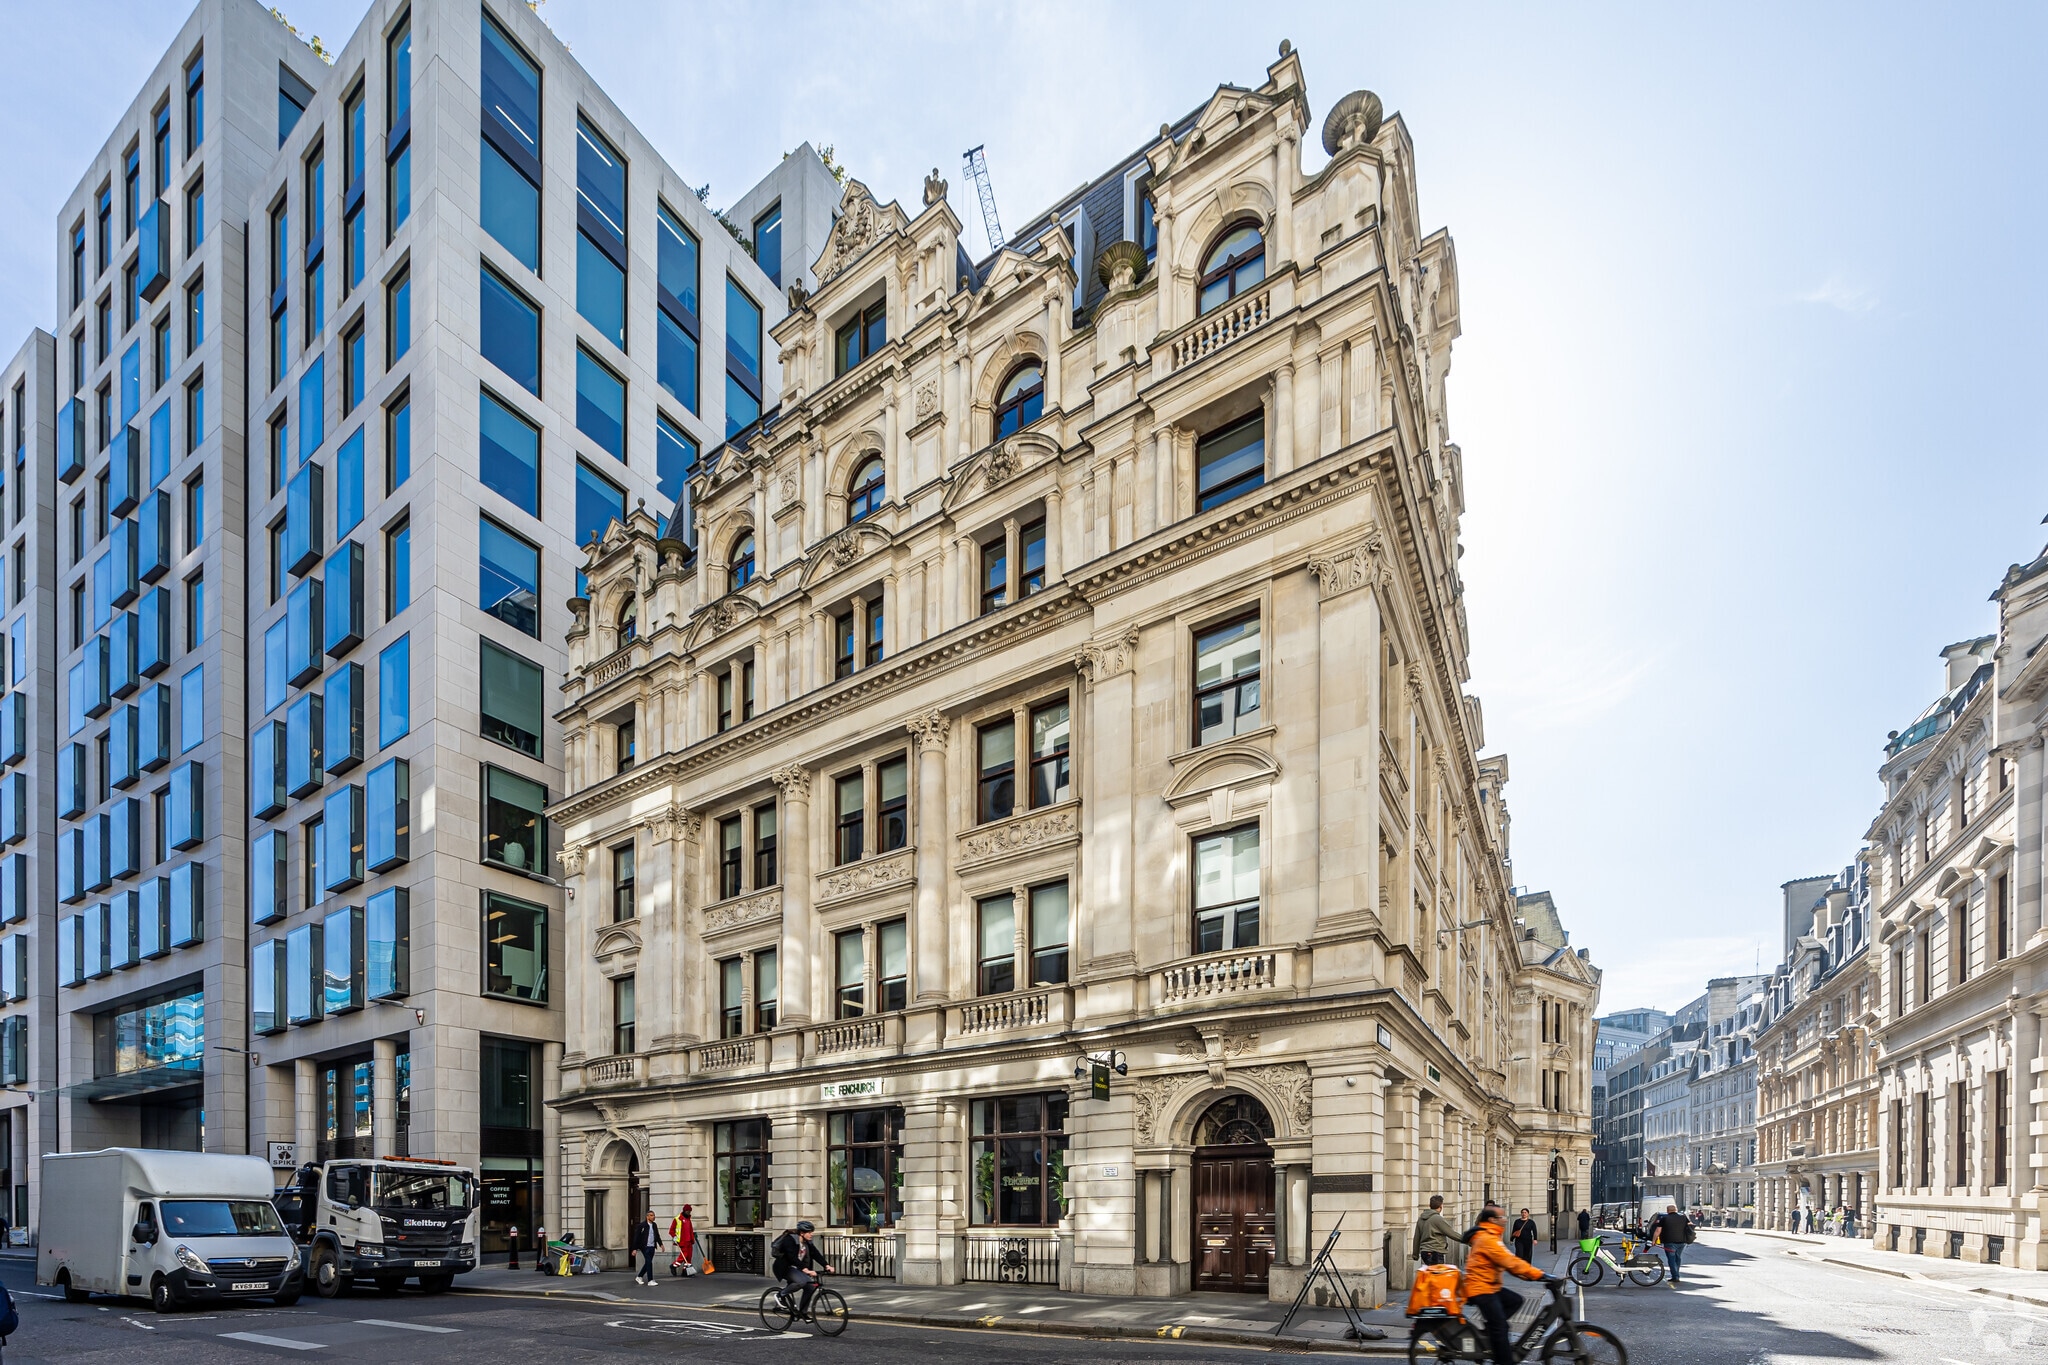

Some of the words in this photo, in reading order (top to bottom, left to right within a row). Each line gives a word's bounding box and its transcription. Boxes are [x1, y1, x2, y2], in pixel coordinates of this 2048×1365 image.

[823, 1086, 836, 1098] THE
[838, 1081, 876, 1095] FENCHURCH
[411, 1219, 447, 1228] keltbray
